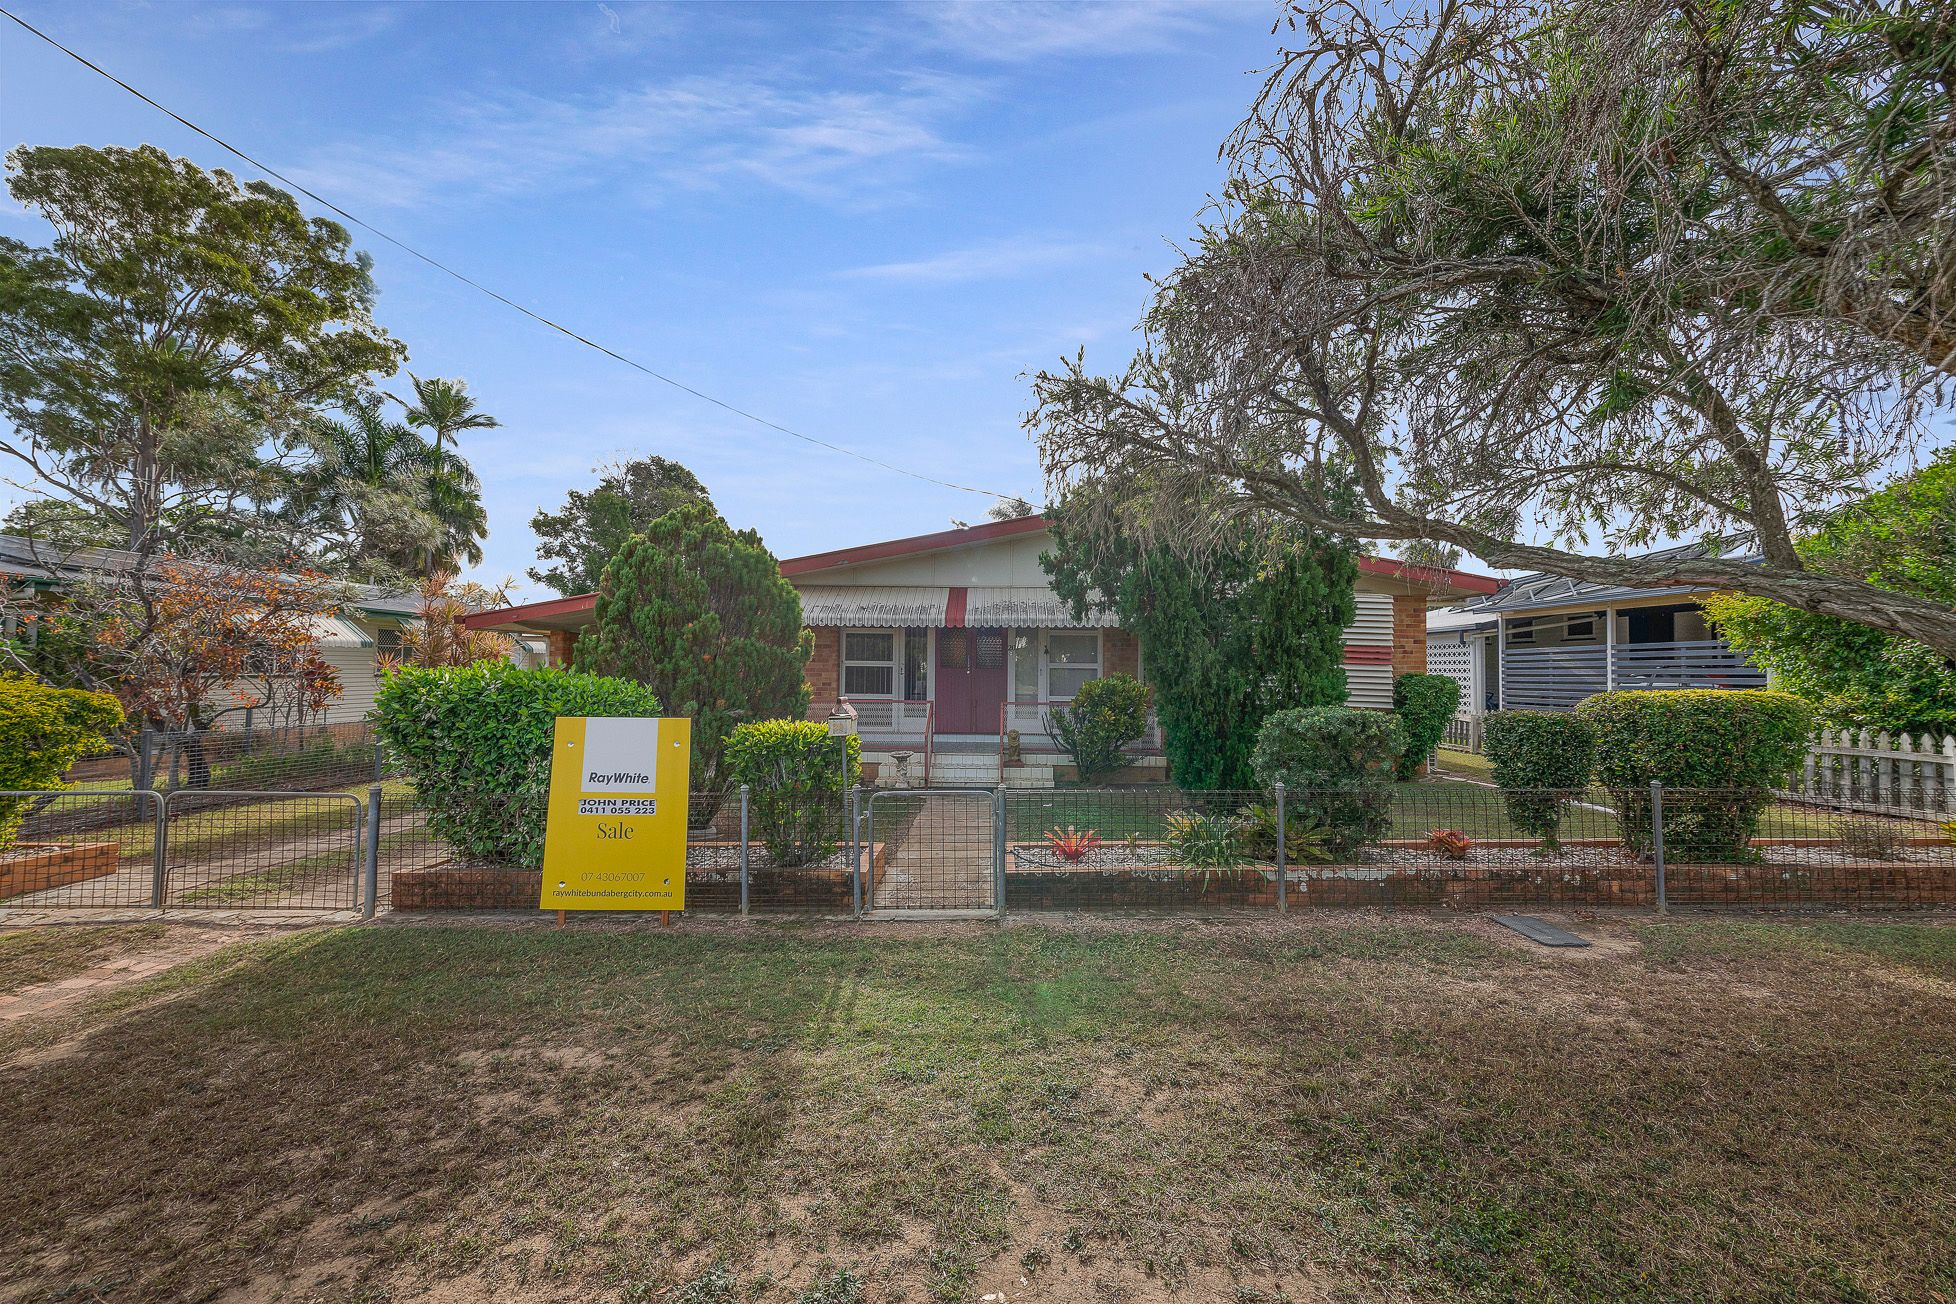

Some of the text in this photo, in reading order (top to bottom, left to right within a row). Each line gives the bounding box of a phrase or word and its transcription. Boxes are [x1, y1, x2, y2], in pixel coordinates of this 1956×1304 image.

[621, 799, 656, 807] PRICE
[597, 821, 634, 840] Sale
[581, 872, 593, 881] 07
[552, 889, 673, 898] raywhitebundabergcity.com.au
